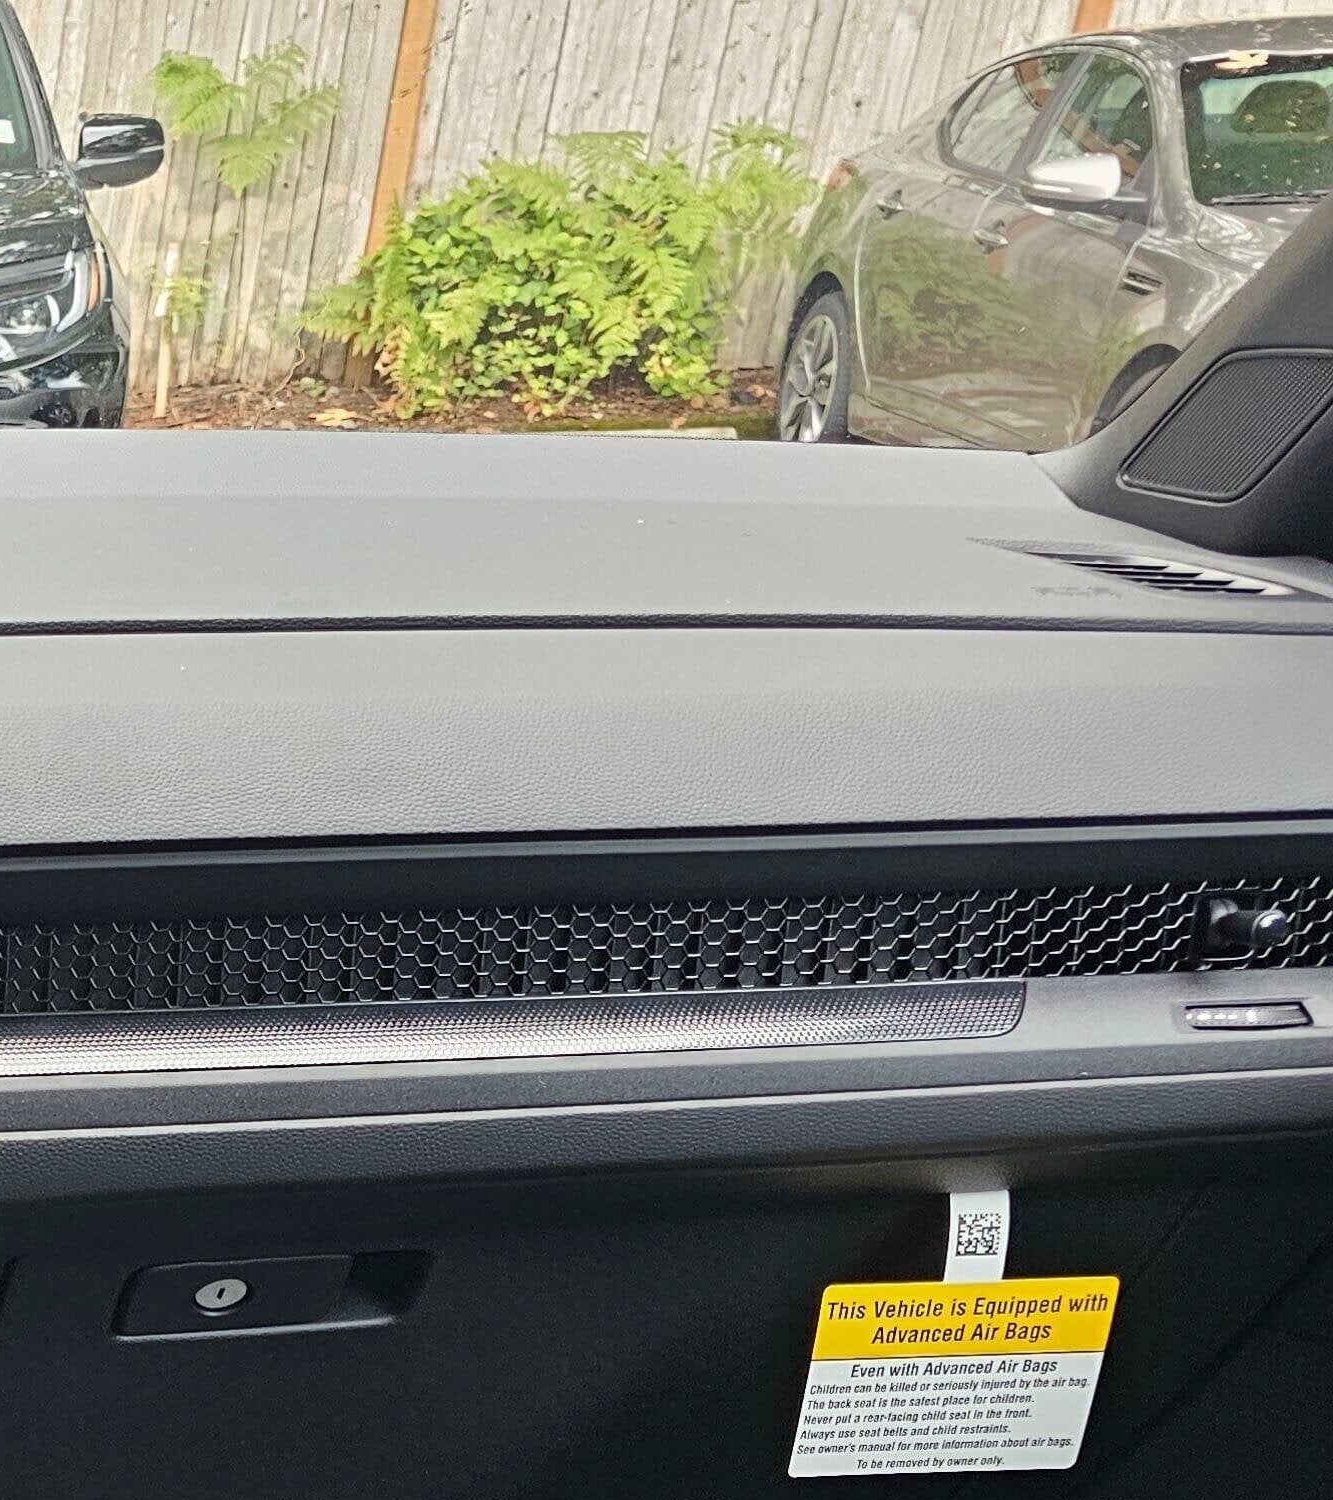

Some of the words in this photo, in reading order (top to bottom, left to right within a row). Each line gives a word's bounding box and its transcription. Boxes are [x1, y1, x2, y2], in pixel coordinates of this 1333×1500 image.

[828, 1302, 866, 1320] This
[874, 1300, 943, 1319] Vehicle
[951, 1298, 967, 1317] is
[973, 1295, 1063, 1319] Equipped
[1069, 1294, 1108, 1312] with
[871, 1324, 966, 1345] Advanced
[970, 1323, 999, 1341] Air
[1005, 1322, 1052, 1343] Bags
[851, 1364, 885, 1378] Even
[889, 1363, 919, 1377] with
[923, 1361, 994, 1376] Advanced
[996, 1360, 1019, 1374] Air
[1022, 1359, 1058, 1375] Bags
[810, 1384, 851, 1395] Children
[854, 1385, 871, 1394] can
[875, 1384, 887, 1393] be
[889, 1382, 917, 1392] killed
[920, 1383, 931, 1391] or
[933, 1380, 978, 1392] seriously
[982, 1379, 1016, 1390] injured
[1019, 1378, 1031, 1390] by
[1033, 1378, 1050, 1388] the
[1052, 1378, 1067, 1387] air
[1068, 1377, 1090, 1389] bag.
[807, 1400, 824, 1410] The
[828, 1400, 851, 1409] back
[854, 1399, 875, 1408] seat
[878, 1398, 887, 1407] is
[890, 1398, 906, 1407] the
[908, 1396, 940, 1406] safest
[942, 1395, 970, 1407] place
[973, 1395, 988, 1405] for
[989, 1394, 1035, 1404] children.
[803, 1415, 833, 1425] Never
[835, 1414, 851, 1425] put
[853, 1415, 860, 1423] a
[863, 1412, 918, 1423] rear-facing
[921, 1411, 946, 1421] child
[949, 1410, 971, 1420] seat
[973, 1409, 983, 1419] in
[986, 1409, 1002, 1419] the
[1004, 1408, 1032, 1418] front.
[800, 1429, 835, 1440] Always
[838, 1430, 856, 1438] use
[858, 1428, 880, 1437] seat
[883, 1427, 907, 1437] belts
[910, 1426, 930, 1436] and
[933, 1425, 957, 1435] child
[959, 1424, 1011, 1434] restraints.
[797, 1444, 815, 1454] See
[818, 1443, 855, 1454] owner's
[858, 1442, 894, 1452] manual
[897, 1442, 911, 1451] for
[913, 1442, 939, 1451] more
[941, 1440, 998, 1450] information
[1001, 1438, 1028, 1448] about
[1031, 1437, 1045, 1447] air
[1048, 1437, 1074, 1448] bags.
[857, 1459, 867, 1469] To
[871, 1459, 883, 1469] be
[885, 1457, 929, 1468] removed
[933, 1457, 944, 1468] by
[947, 1457, 978, 1467] owner
[980, 1455, 1005, 1467] only.
